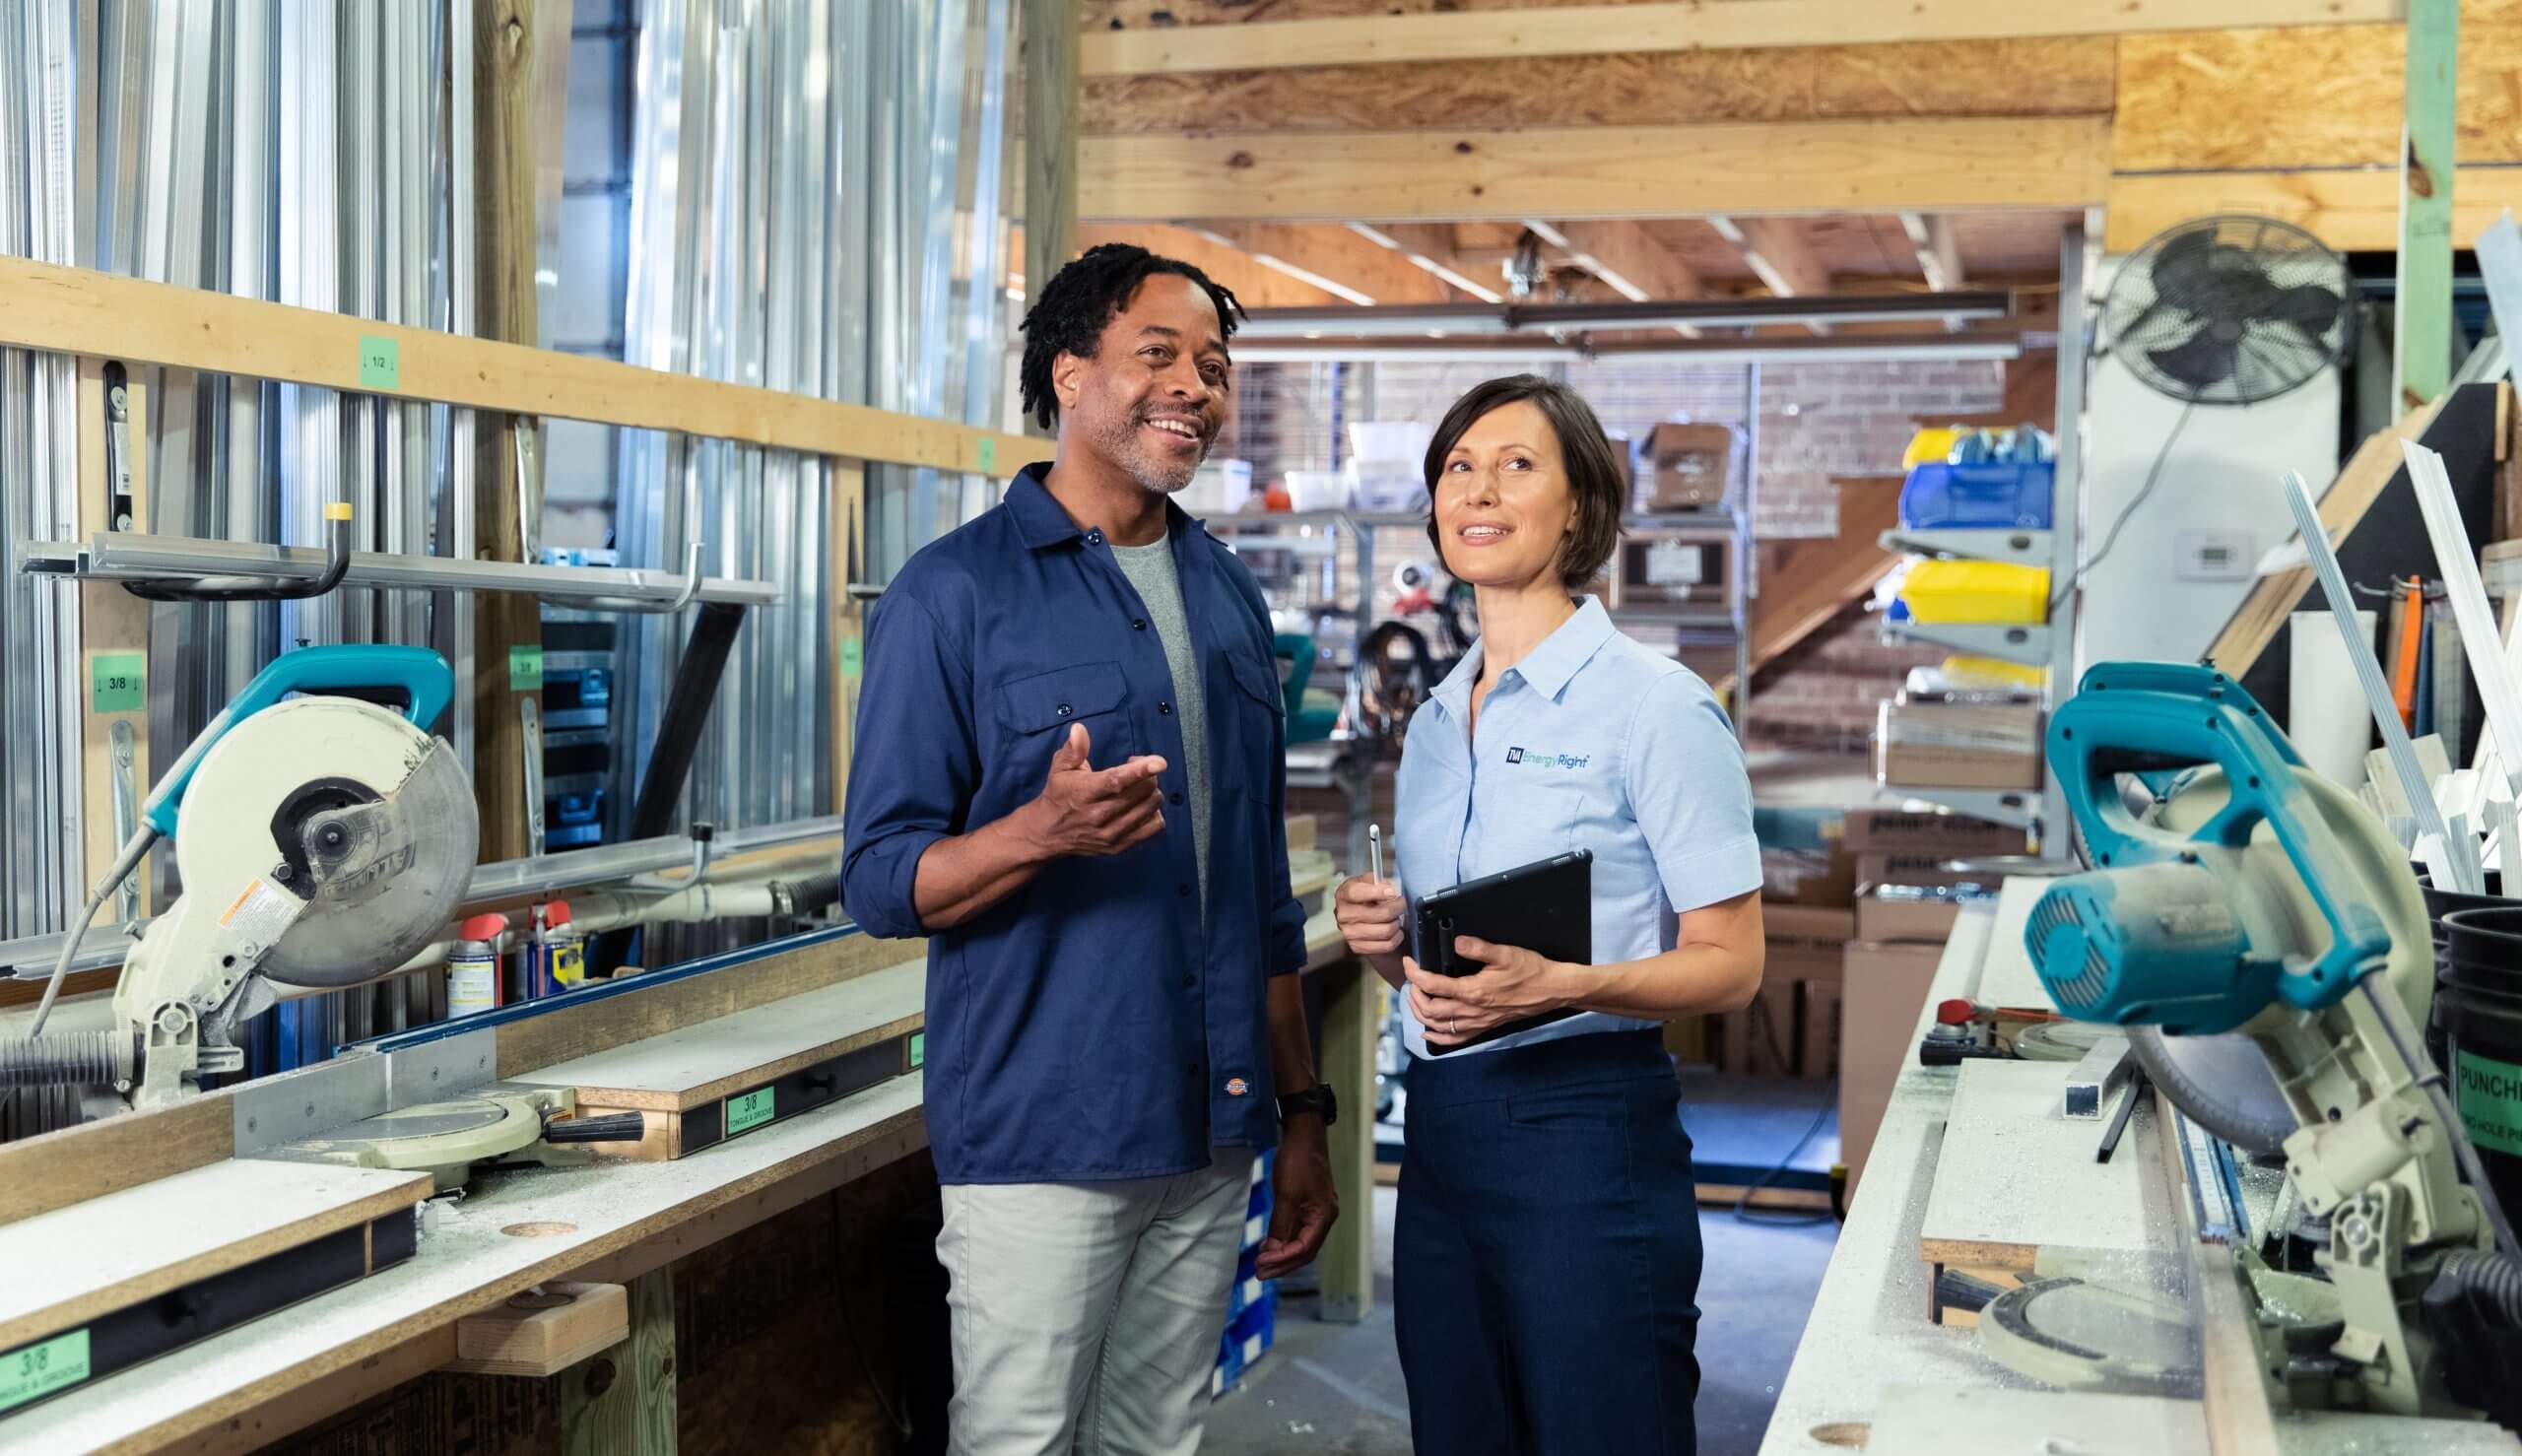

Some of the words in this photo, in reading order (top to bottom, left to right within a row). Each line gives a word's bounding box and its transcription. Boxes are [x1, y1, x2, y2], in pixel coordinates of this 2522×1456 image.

[372, 356, 385, 368] 1/2
[109, 677, 126, 690] 3/8
[2460, 1065, 2522, 1101] PUNCH
[744, 1093, 758, 1111] 3/8
[20, 1346, 48, 1377] 3/8
